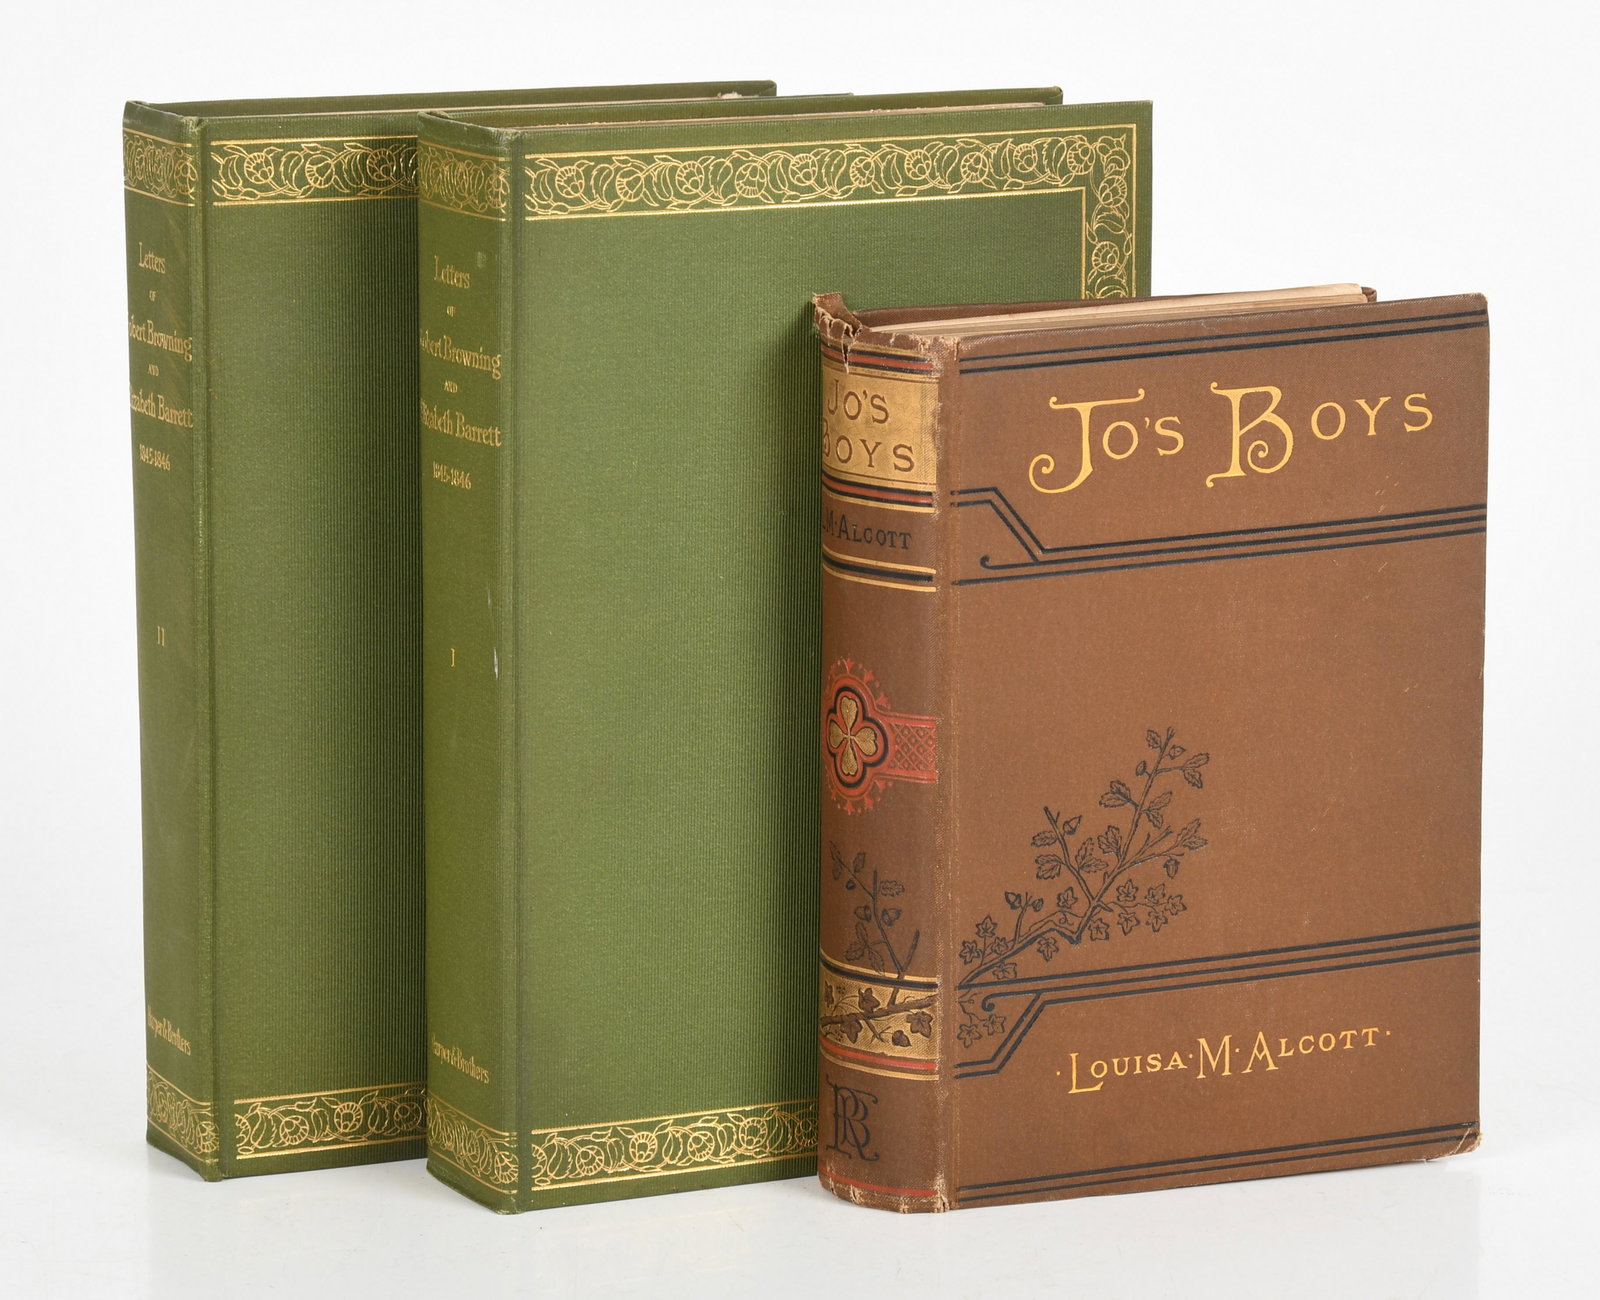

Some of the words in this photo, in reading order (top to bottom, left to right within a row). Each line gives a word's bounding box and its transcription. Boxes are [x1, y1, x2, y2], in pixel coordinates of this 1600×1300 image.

[138, 242, 166, 274] Letters
[434, 255, 470, 289] Letters
[446, 305, 456, 317] OF
[147, 319, 192, 362] Browning
[443, 335, 502, 380] Browning
[444, 380, 458, 393] AND
[827, 378, 889, 424] JO'S
[158, 394, 193, 428] Barrett
[456, 411, 502, 447] Barrett
[1028, 388, 1185, 494] JO'S
[1206, 381, 1434, 488] BOYS
[837, 513, 912, 550] ALCOTT
